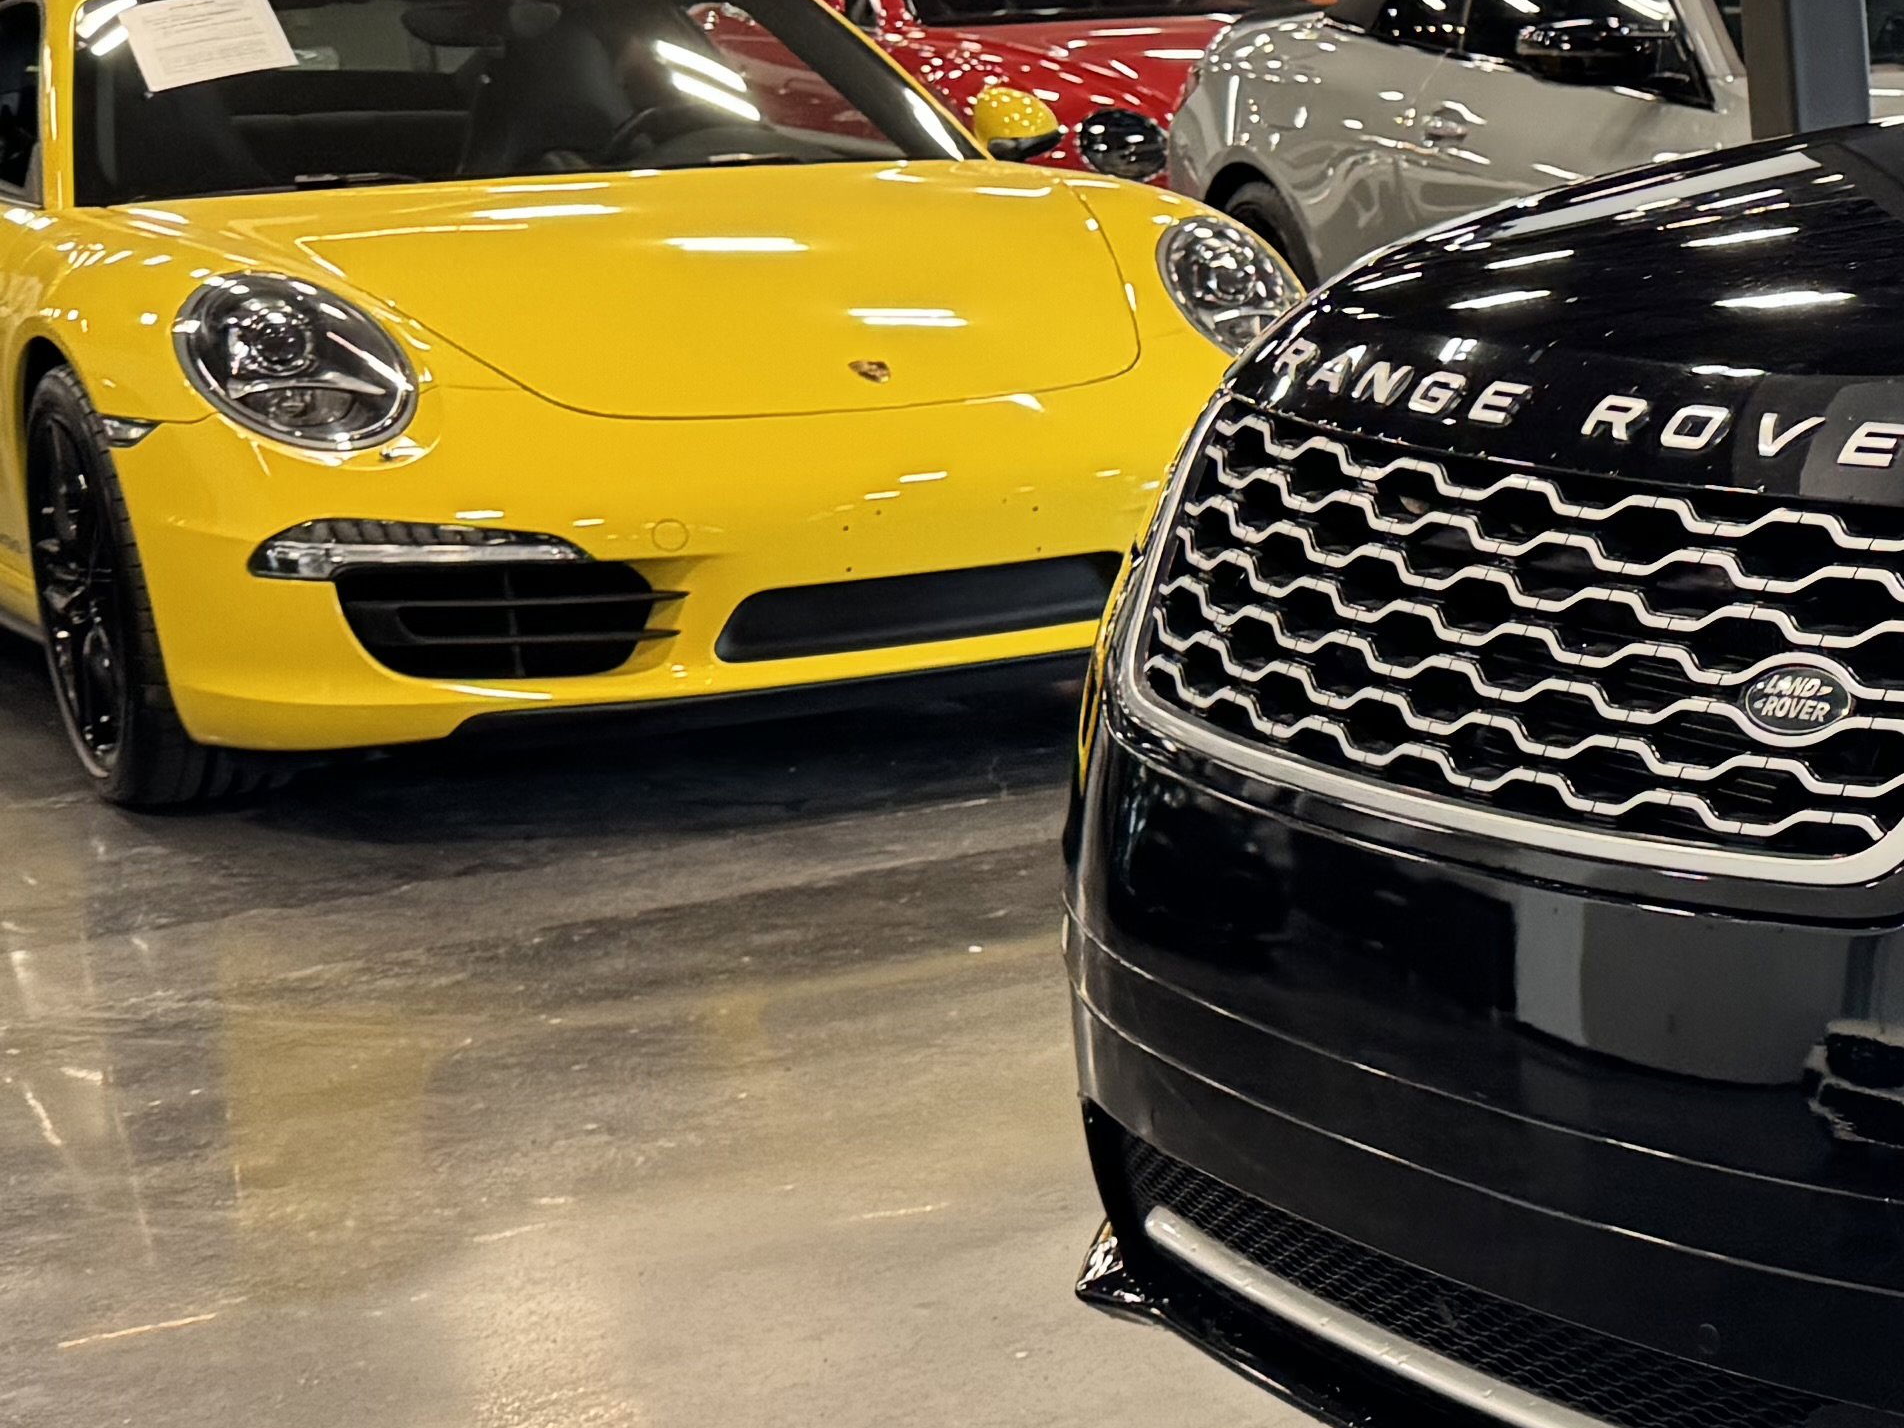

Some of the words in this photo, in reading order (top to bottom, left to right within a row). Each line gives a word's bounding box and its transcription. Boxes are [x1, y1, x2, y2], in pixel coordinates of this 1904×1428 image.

[1272, 337, 1533, 425] RANGE
[1763, 674, 1821, 698] LAND
[1761, 695, 1831, 723] ROVER
